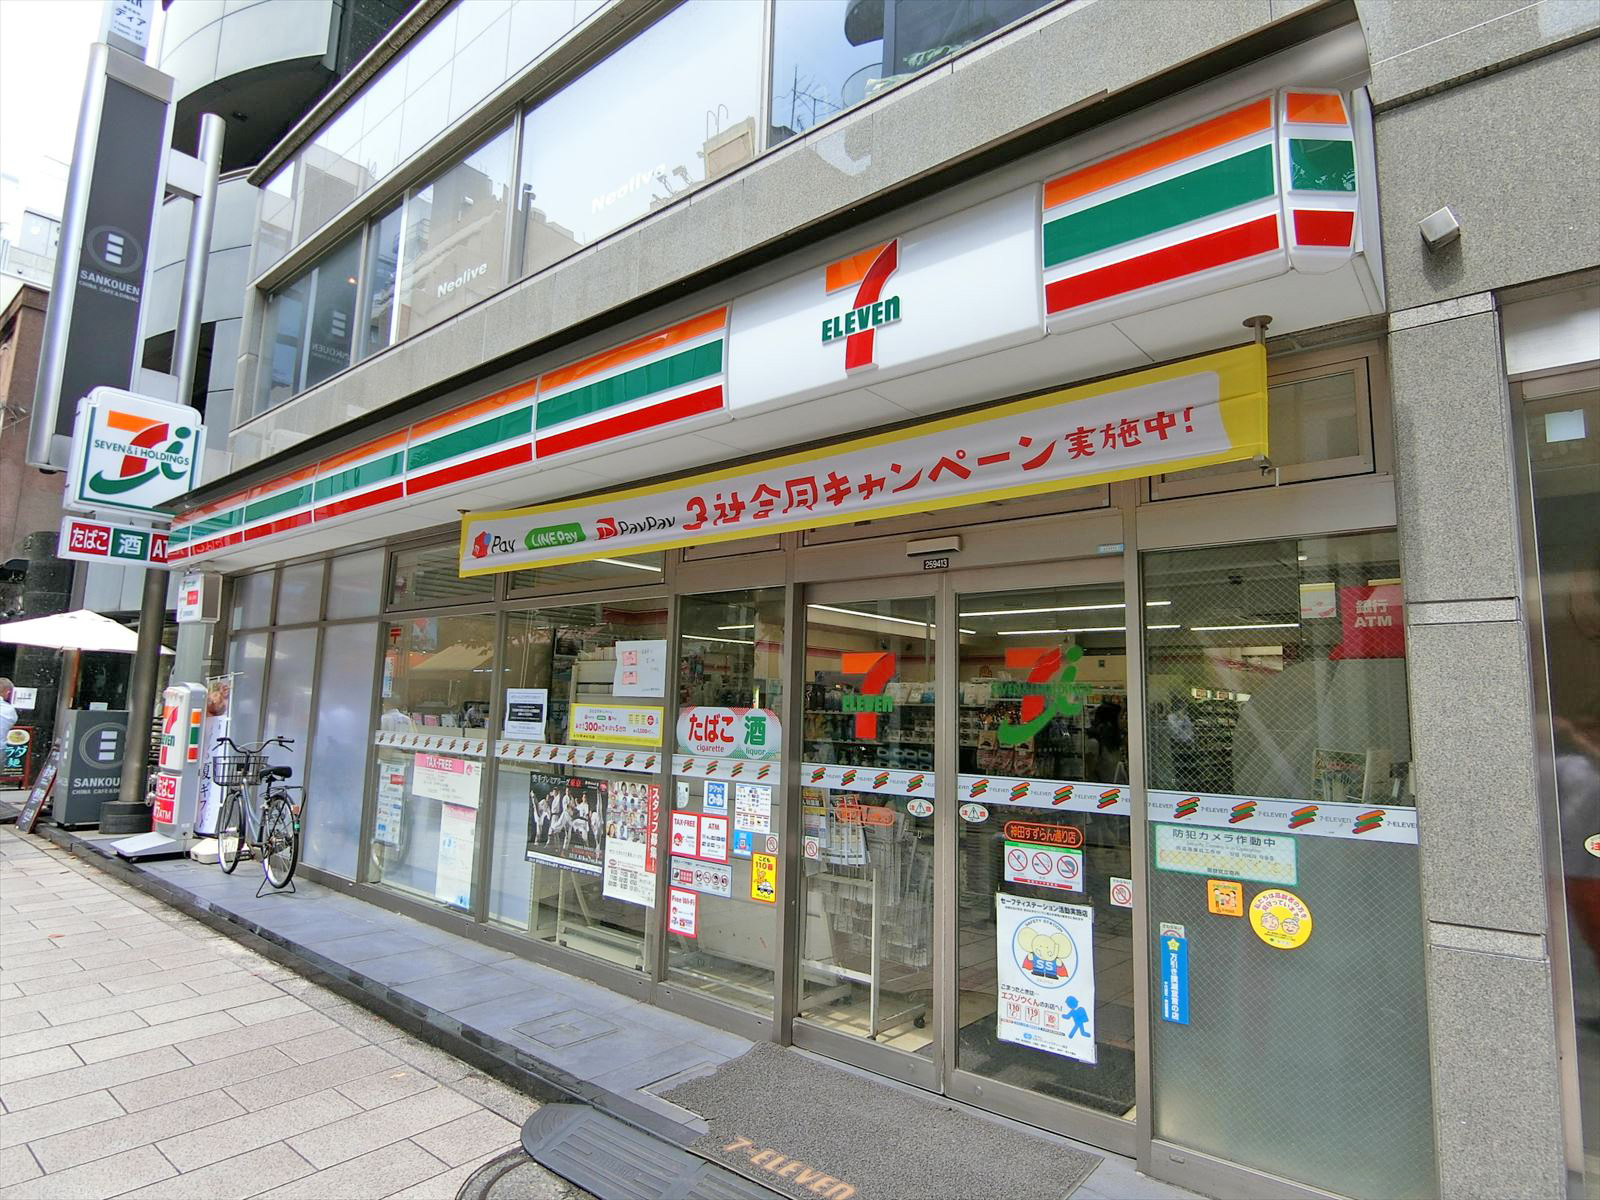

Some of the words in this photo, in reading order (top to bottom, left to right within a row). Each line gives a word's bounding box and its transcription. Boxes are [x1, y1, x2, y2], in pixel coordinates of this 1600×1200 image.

[591, 162, 667, 214] Neolive
[80, 270, 140, 295] SANKOUEN
[437, 262, 488, 298] Neolive
[140, 449, 190, 466] HOLDINGS
[71, 527, 108, 551] たばこ
[118, 533, 144, 556] 酒
[491, 535, 516, 554] Pay
[531, 532, 558, 548] LINE
[557, 531, 578, 545] Pay
[617, 515, 676, 536] PayPay
[925, 558, 948, 570] 259413
[1354, 615, 1392, 628] ATM
[688, 713, 735, 743] たばこ
[744, 716, 767, 746] 酒
[697, 744, 725, 753] cigarette
[745, 747, 767, 756] liquor
[73, 777, 120, 788] SANKOU
[707, 822, 720, 831] ATM
[1172, 828, 1276, 847] 防犯カメラ作動中
[672, 895, 683, 904] Free
[1024, 919, 1042, 927] SAFETY
[1036, 959, 1054, 972] SS
[1008, 1002, 1020, 1012] 110
[1027, 1007, 1039, 1017] 119
